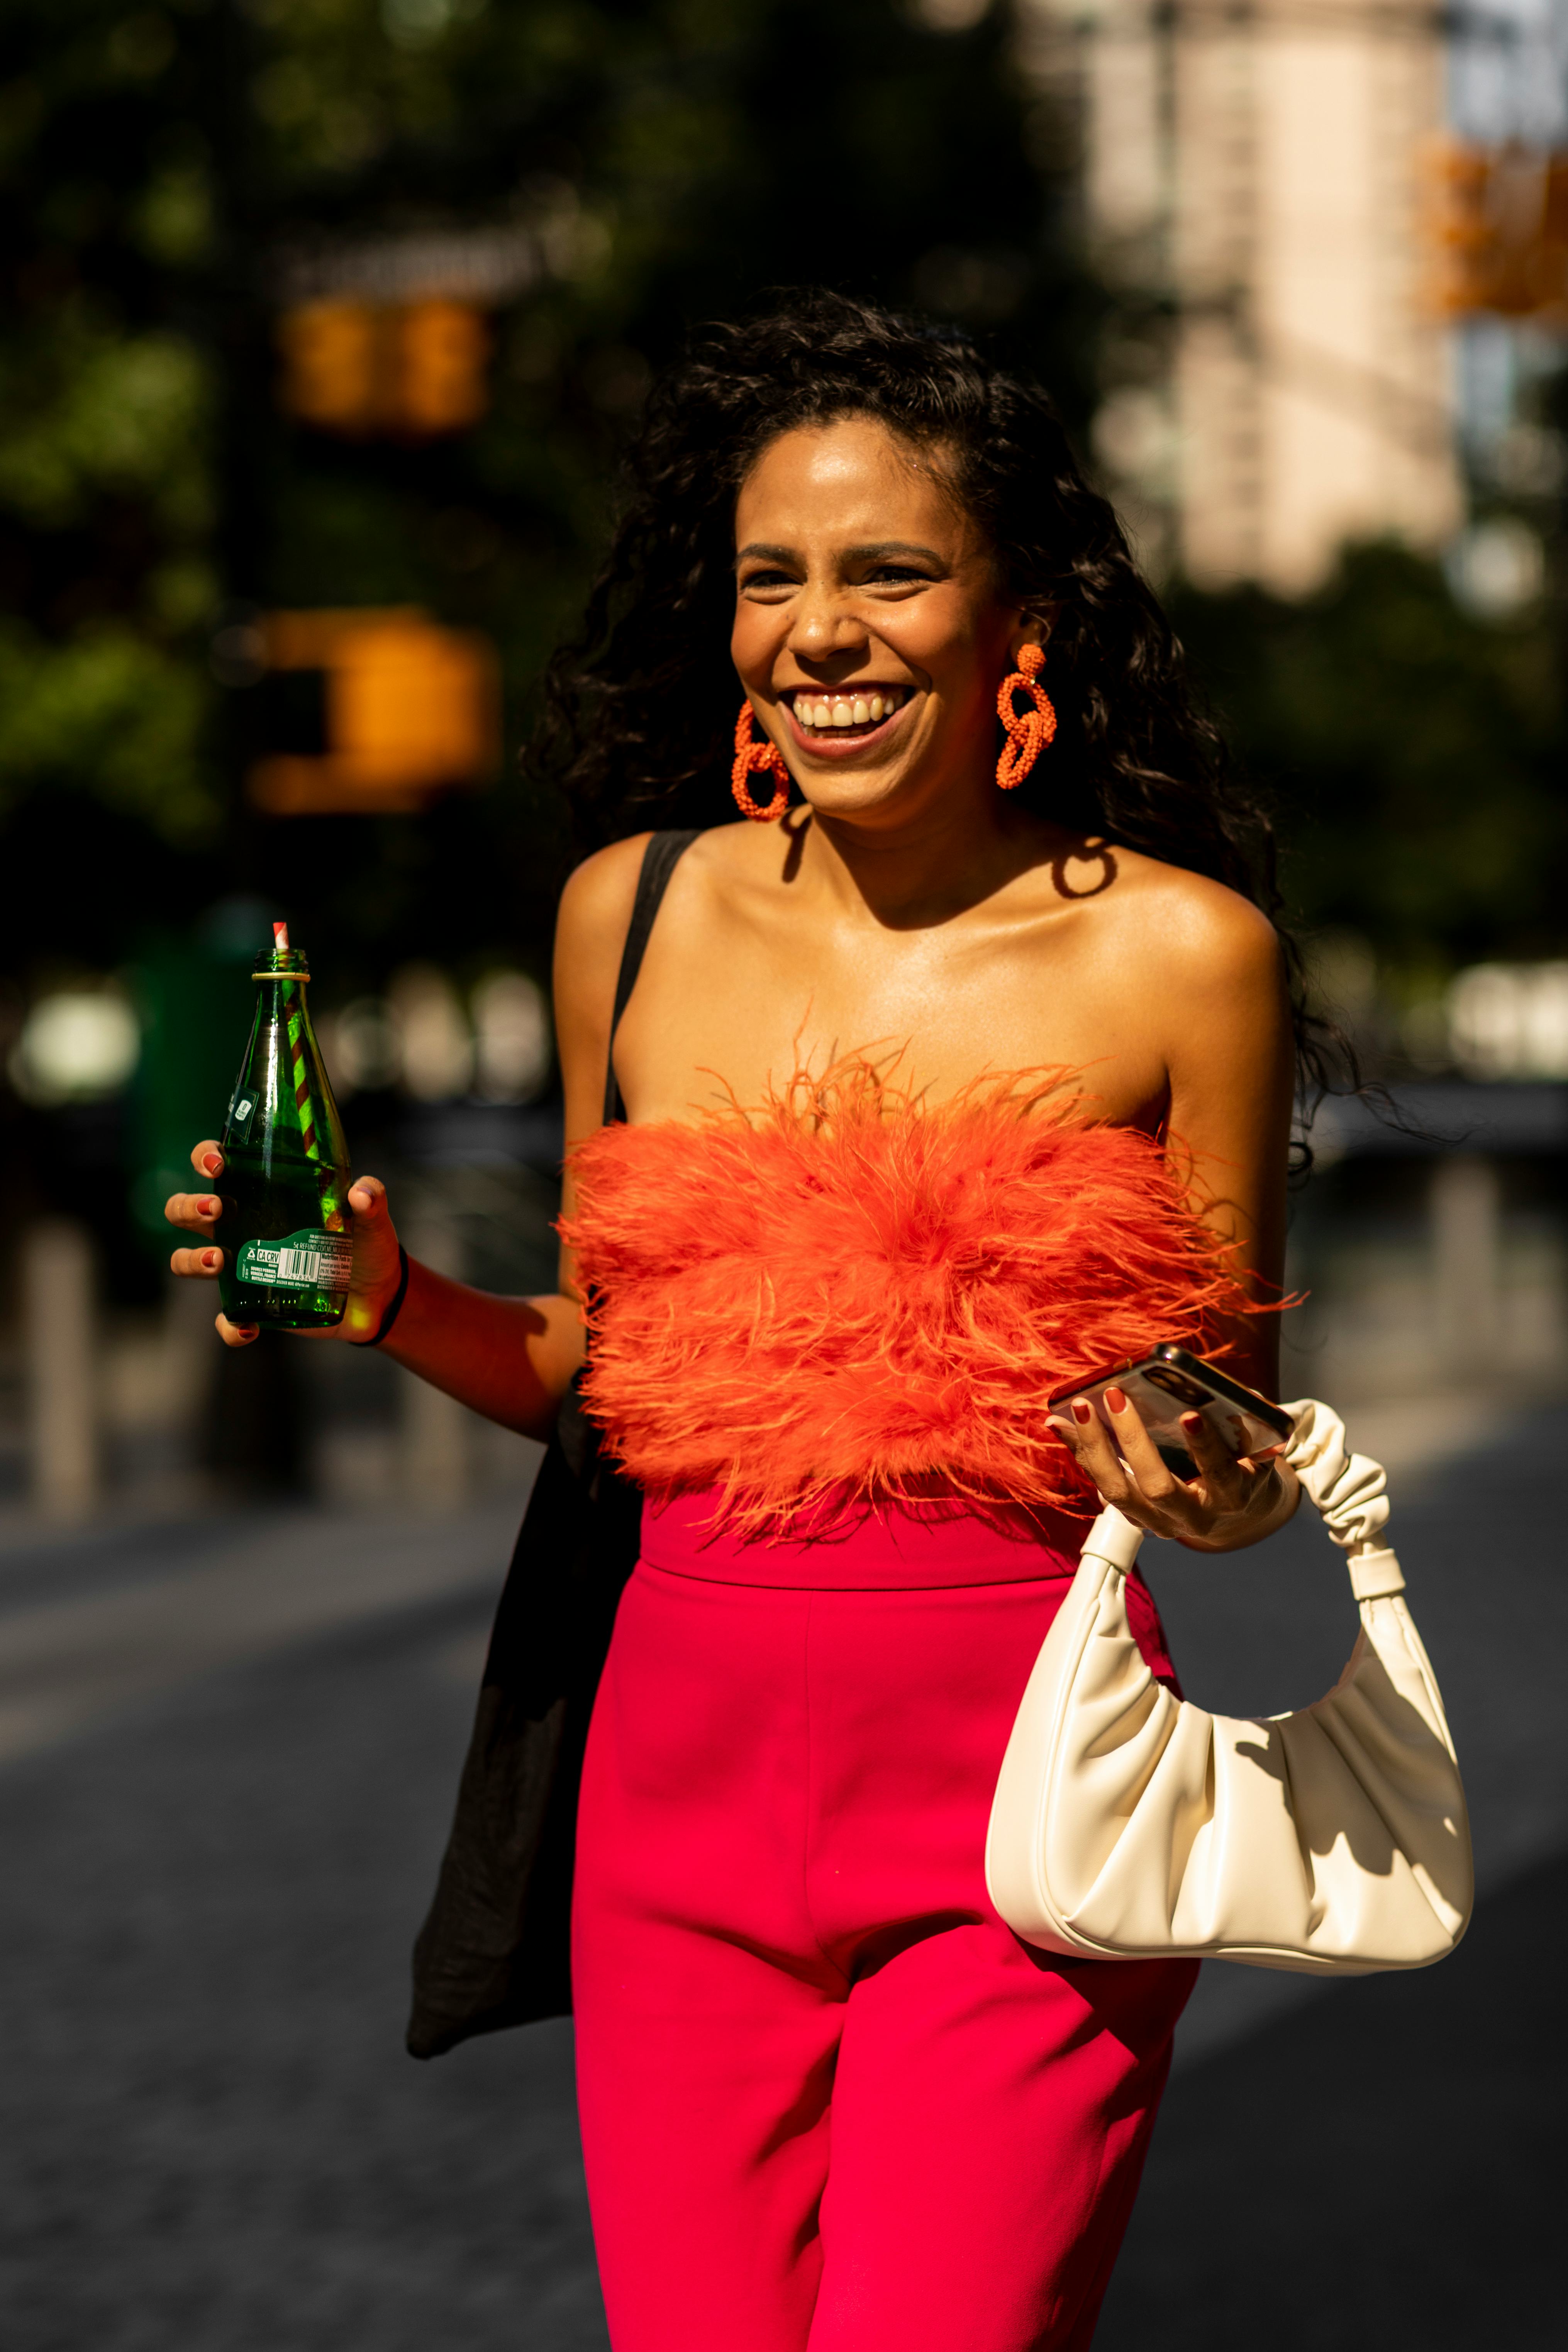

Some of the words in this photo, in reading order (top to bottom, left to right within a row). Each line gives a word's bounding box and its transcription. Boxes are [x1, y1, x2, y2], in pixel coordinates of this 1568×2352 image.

[300, 1242, 317, 1251] REFUND
[258, 1251, 265, 1261] CA
[267, 1252, 279, 1262] CRV
